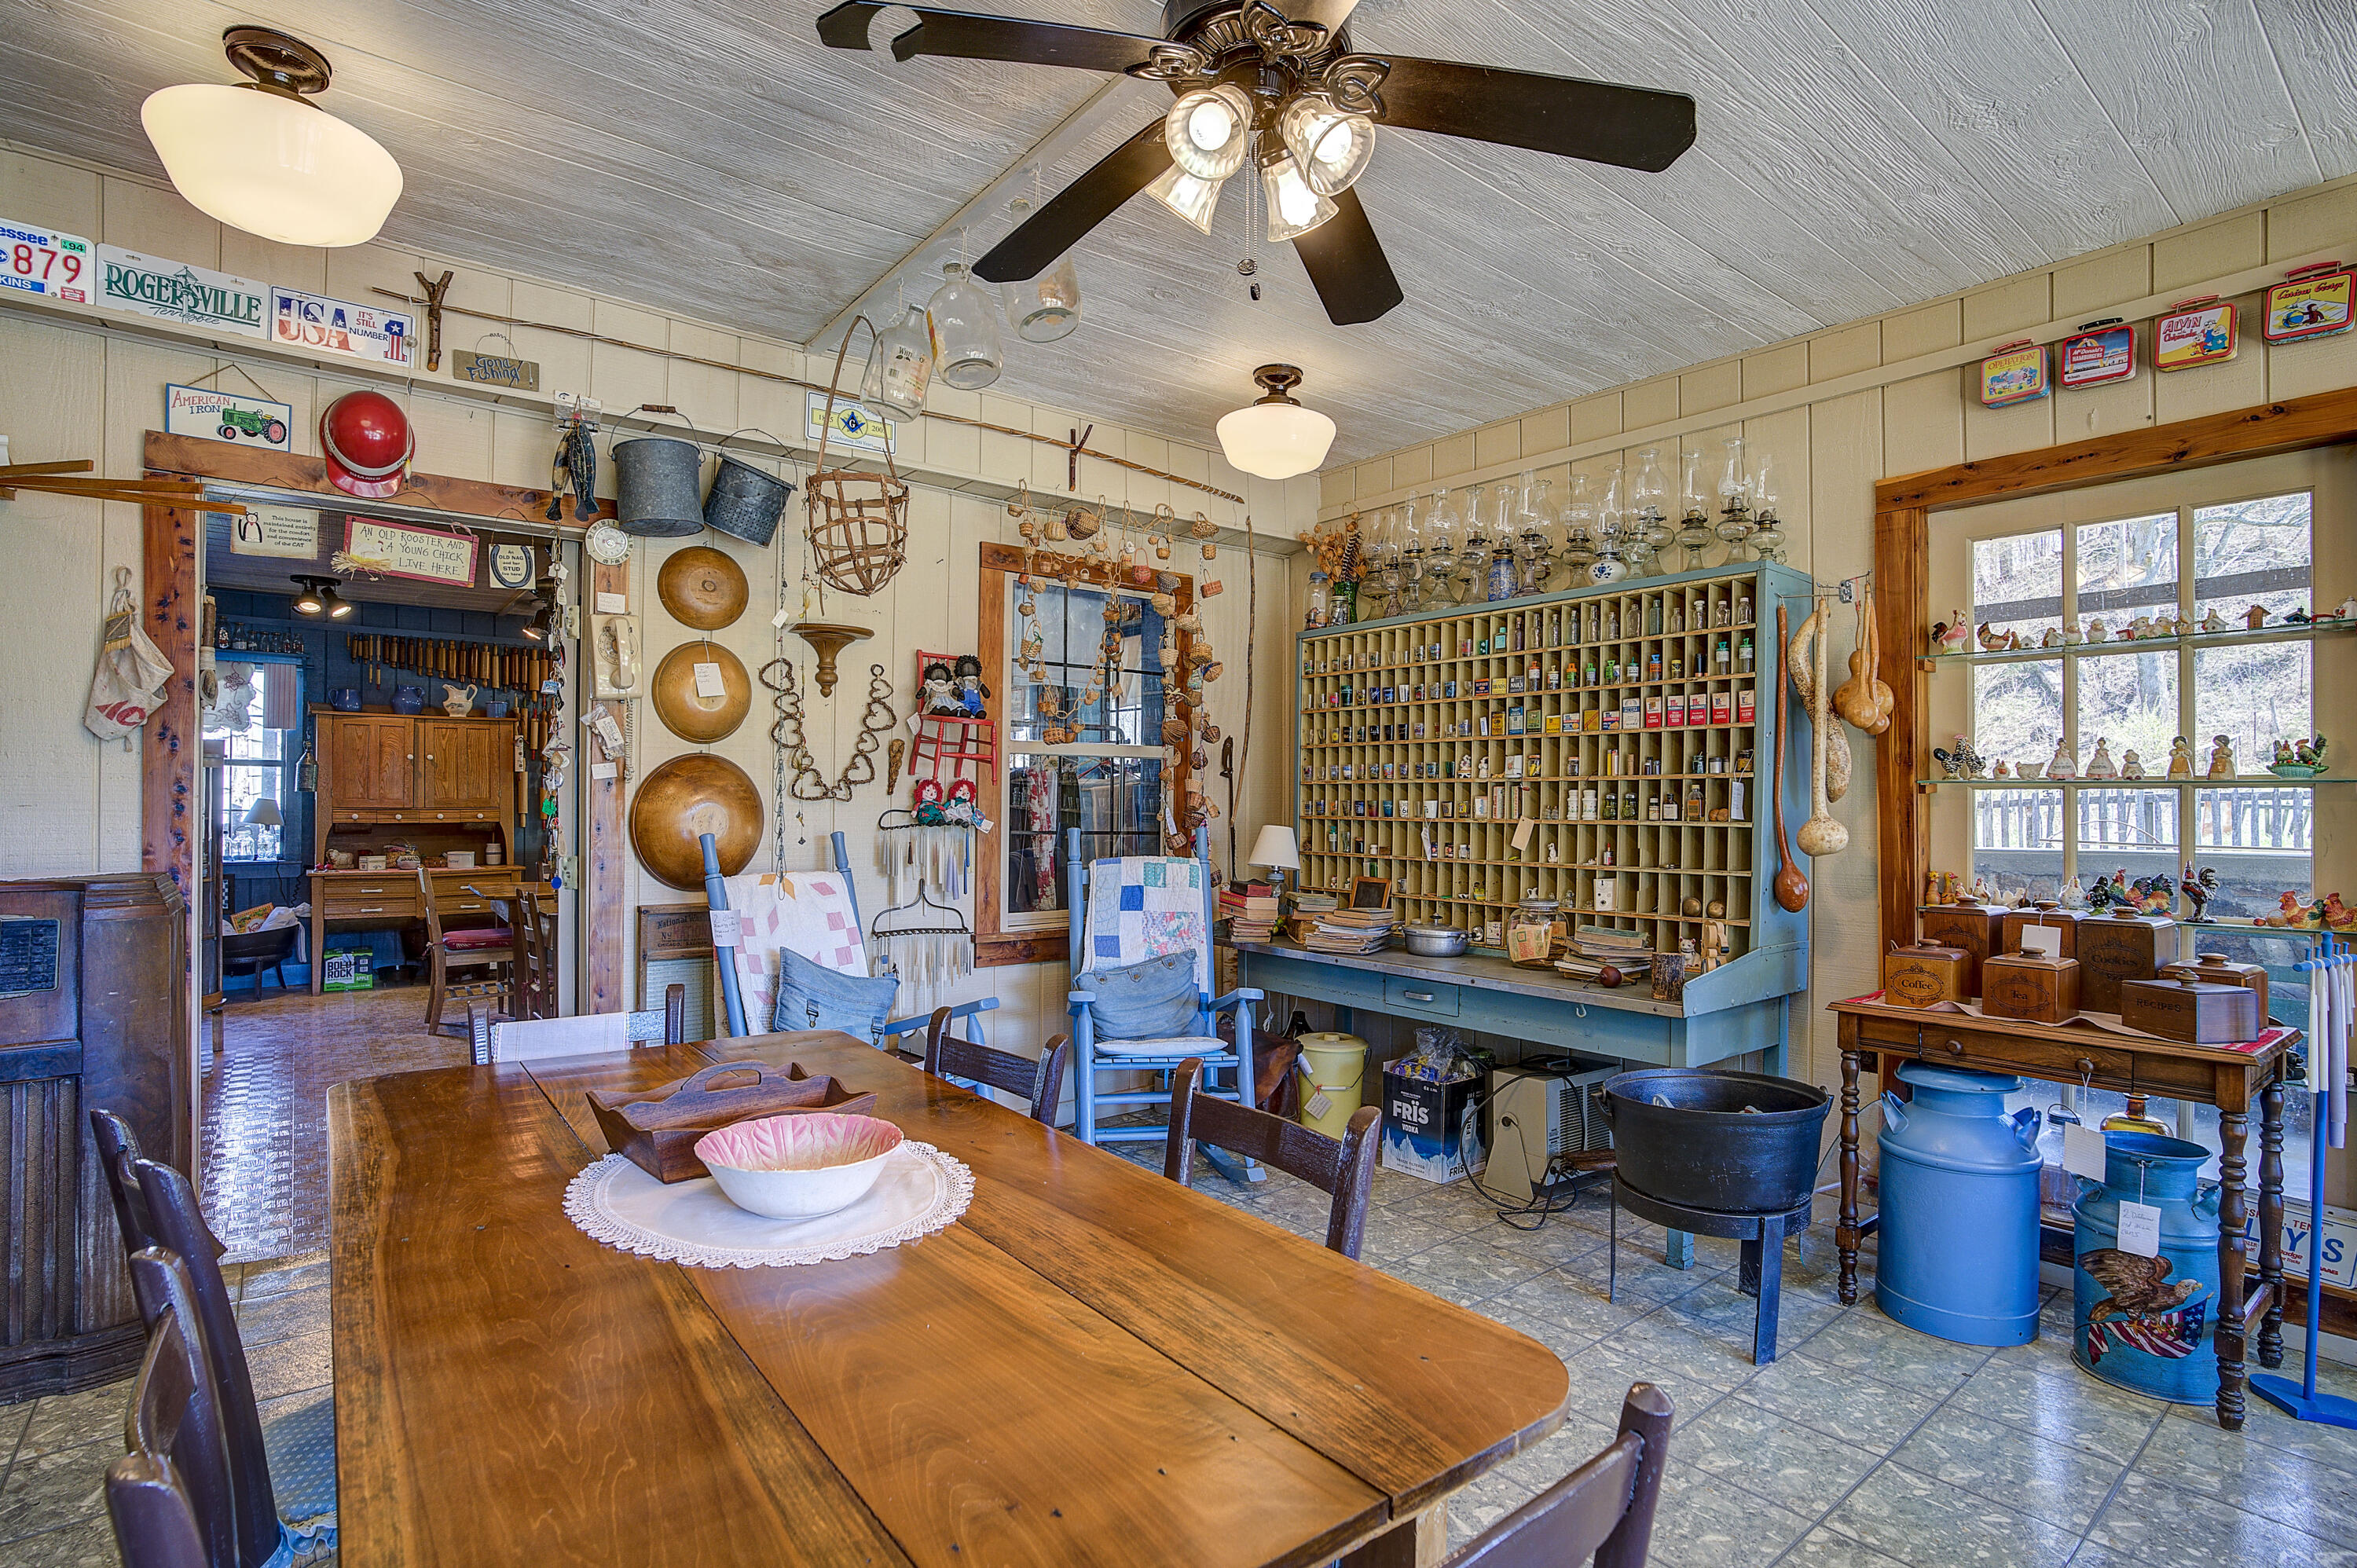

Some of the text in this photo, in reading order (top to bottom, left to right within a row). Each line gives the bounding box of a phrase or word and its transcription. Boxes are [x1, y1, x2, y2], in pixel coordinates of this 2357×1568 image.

[68, 243, 84, 251] 94
[13, 244, 81, 284] 879
[105, 264, 262, 324] ROGERSVILLE
[358, 310, 373, 320] IT'S
[275, 295, 355, 352] USA
[356, 318, 377, 328] STILL
[2163, 316, 2202, 334] ALVIN
[349, 326, 389, 341] NUMBER
[1988, 351, 2036, 370] OPERATION
[2073, 353, 2102, 362] HAMBURGERS
[171, 390, 230, 408] AMERICAN
[189, 405, 222, 415] IRON
[849, 419, 856, 428] G
[361, 526, 465, 550] AN OLD ROOSTER AND
[387, 542, 464, 564] A YOUNG CHICK
[398, 557, 460, 576] LIVE HERE
[328, 961, 351, 972] BOLD
[2091, 954, 2139, 967] Cookies
[328, 968, 352, 978] ROCK
[1901, 979, 1933, 990] Coffee
[2011, 990, 2028, 1000] Tea
[2136, 998, 2181, 1012] RECIPES
[1393, 1100, 1429, 1124] FRÏS
[1402, 1123, 1419, 1134] VODKA
